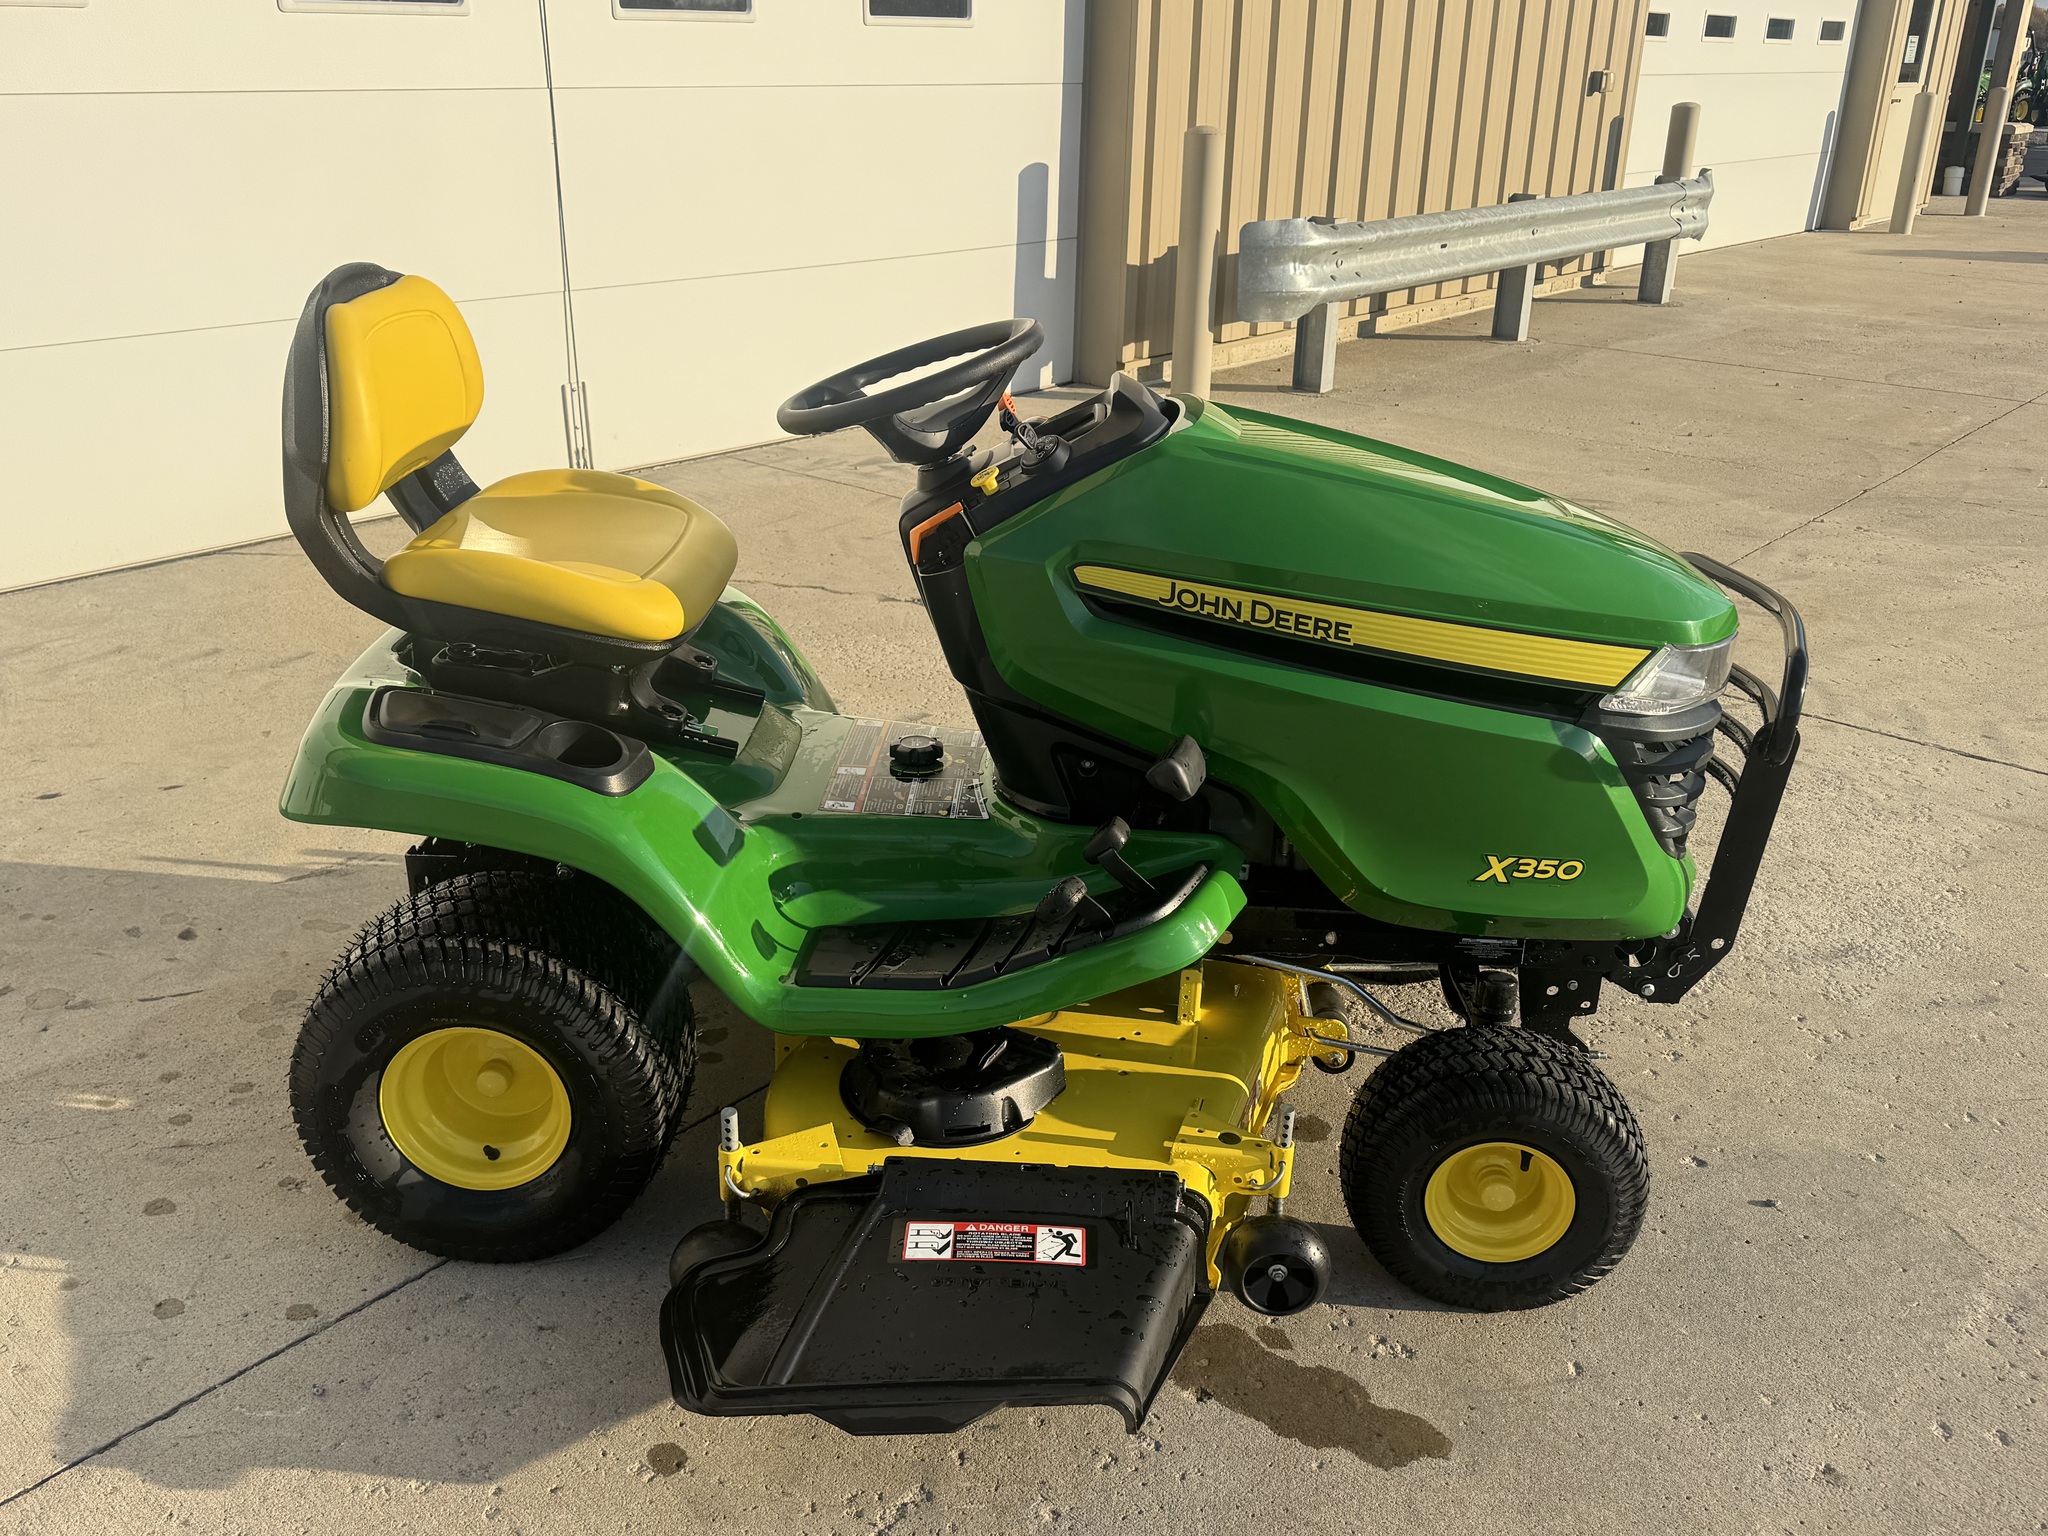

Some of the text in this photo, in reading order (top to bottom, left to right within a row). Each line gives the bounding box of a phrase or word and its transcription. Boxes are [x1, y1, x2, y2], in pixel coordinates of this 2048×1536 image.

[1159, 581, 1353, 643] JOHN DEERE
[1473, 854, 1584, 883] X350
[979, 1224, 1029, 1232] DANGER
